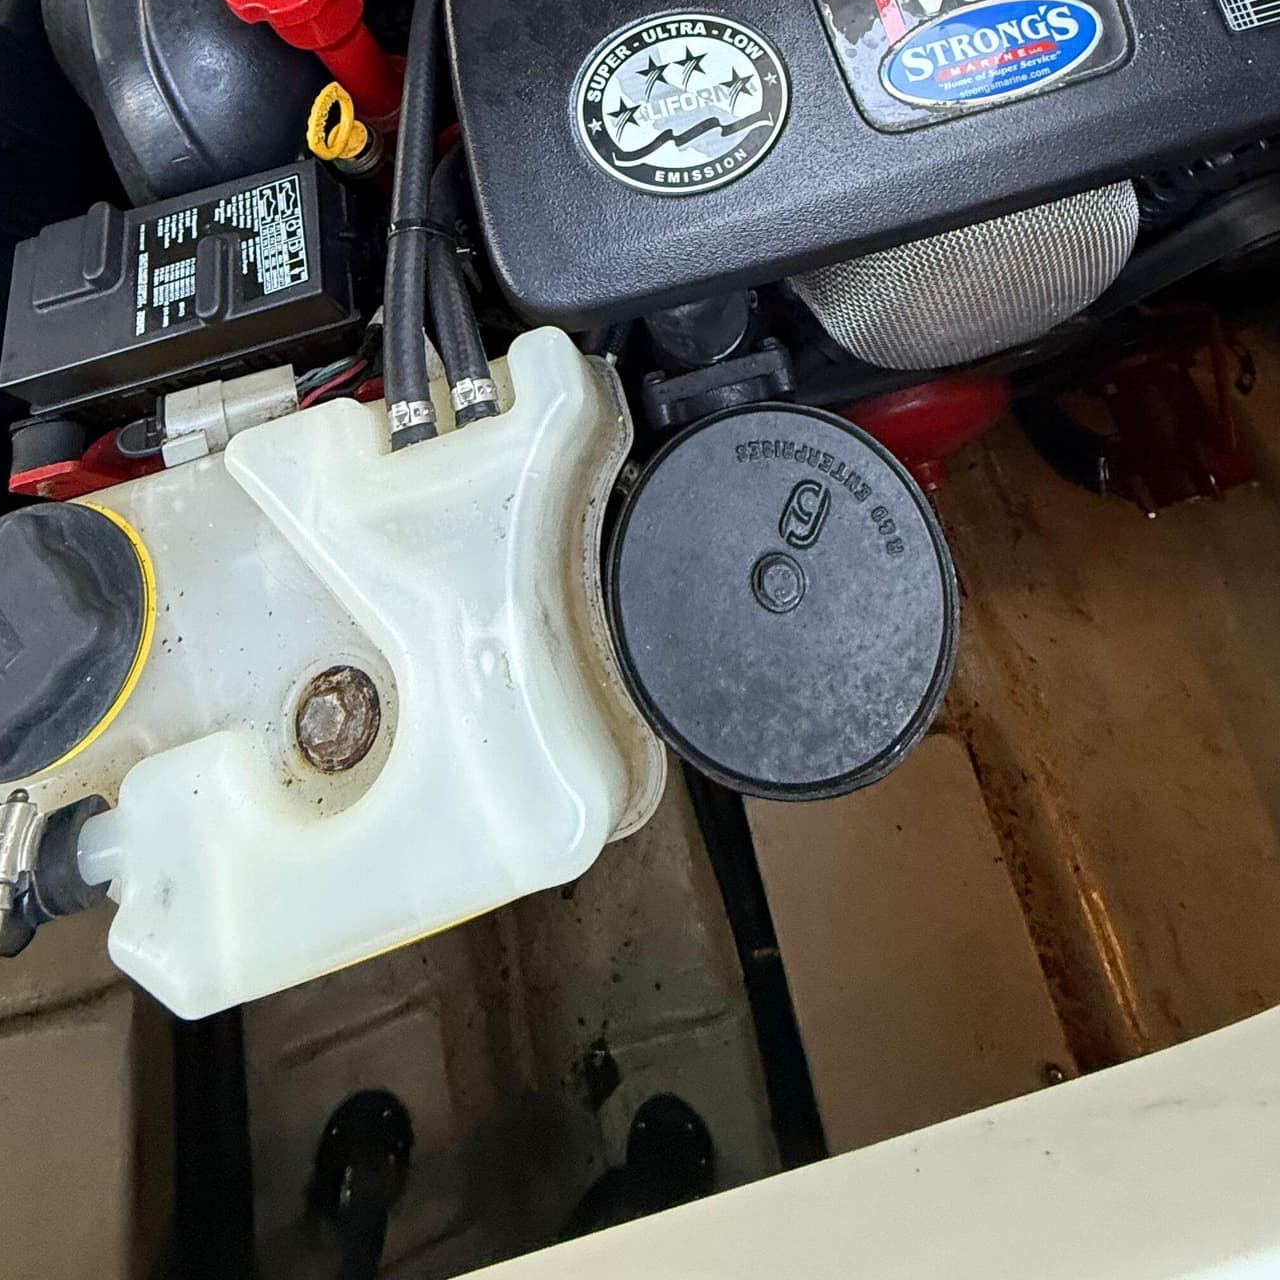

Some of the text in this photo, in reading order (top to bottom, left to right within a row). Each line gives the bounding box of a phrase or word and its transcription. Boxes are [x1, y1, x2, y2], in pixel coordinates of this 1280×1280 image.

[587, 45, 633, 103] SUPER
[641, 21, 707, 44] ULTRA
[722, 27, 765, 61] LOW
[900, 5, 1079, 83] STRONG'S
[950, 48, 1026, 77] MARINE
[975, 72, 988, 83] of
[988, 62, 1018, 83] Super
[959, 66, 1051, 99] strongsmarine.com
[654, 148, 748, 184] EMISSION
[735, 438, 872, 504] ENTERPRISES
